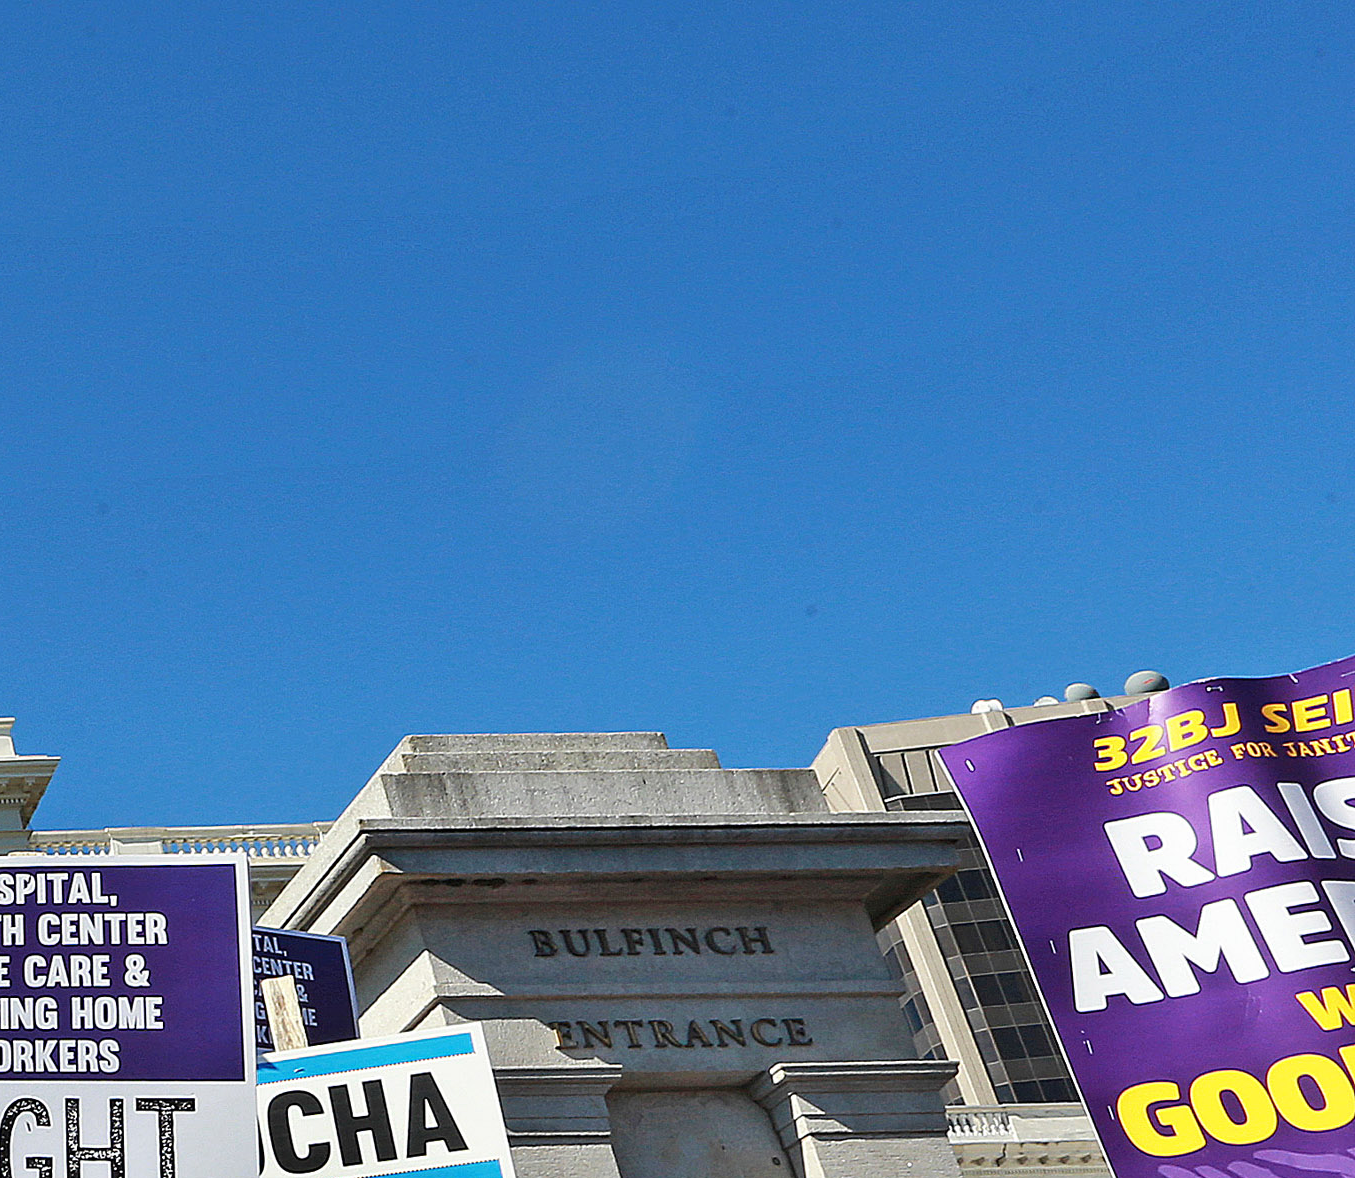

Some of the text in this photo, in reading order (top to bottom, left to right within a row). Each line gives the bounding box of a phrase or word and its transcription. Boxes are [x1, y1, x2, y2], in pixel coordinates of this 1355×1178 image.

[1093, 689, 1354, 773] 32BJ SEI
[1106, 752, 1223, 797] JUSTICE
[1231, 740, 1279, 761] FOR
[1103, 781, 1355, 899] RAIS
[38, 912, 168, 945] CENTER
[530, 925, 777, 960] BULFINCH
[24, 954, 110, 988] CARE
[124, 953, 150, 988] &
[253, 956, 314, 980] CENTER
[71, 996, 164, 1030] HOME
[556, 1017, 815, 1050] ENTRANCE
[261, 1070, 469, 1175] CHA
[1115, 1053, 1355, 1158] GOO
